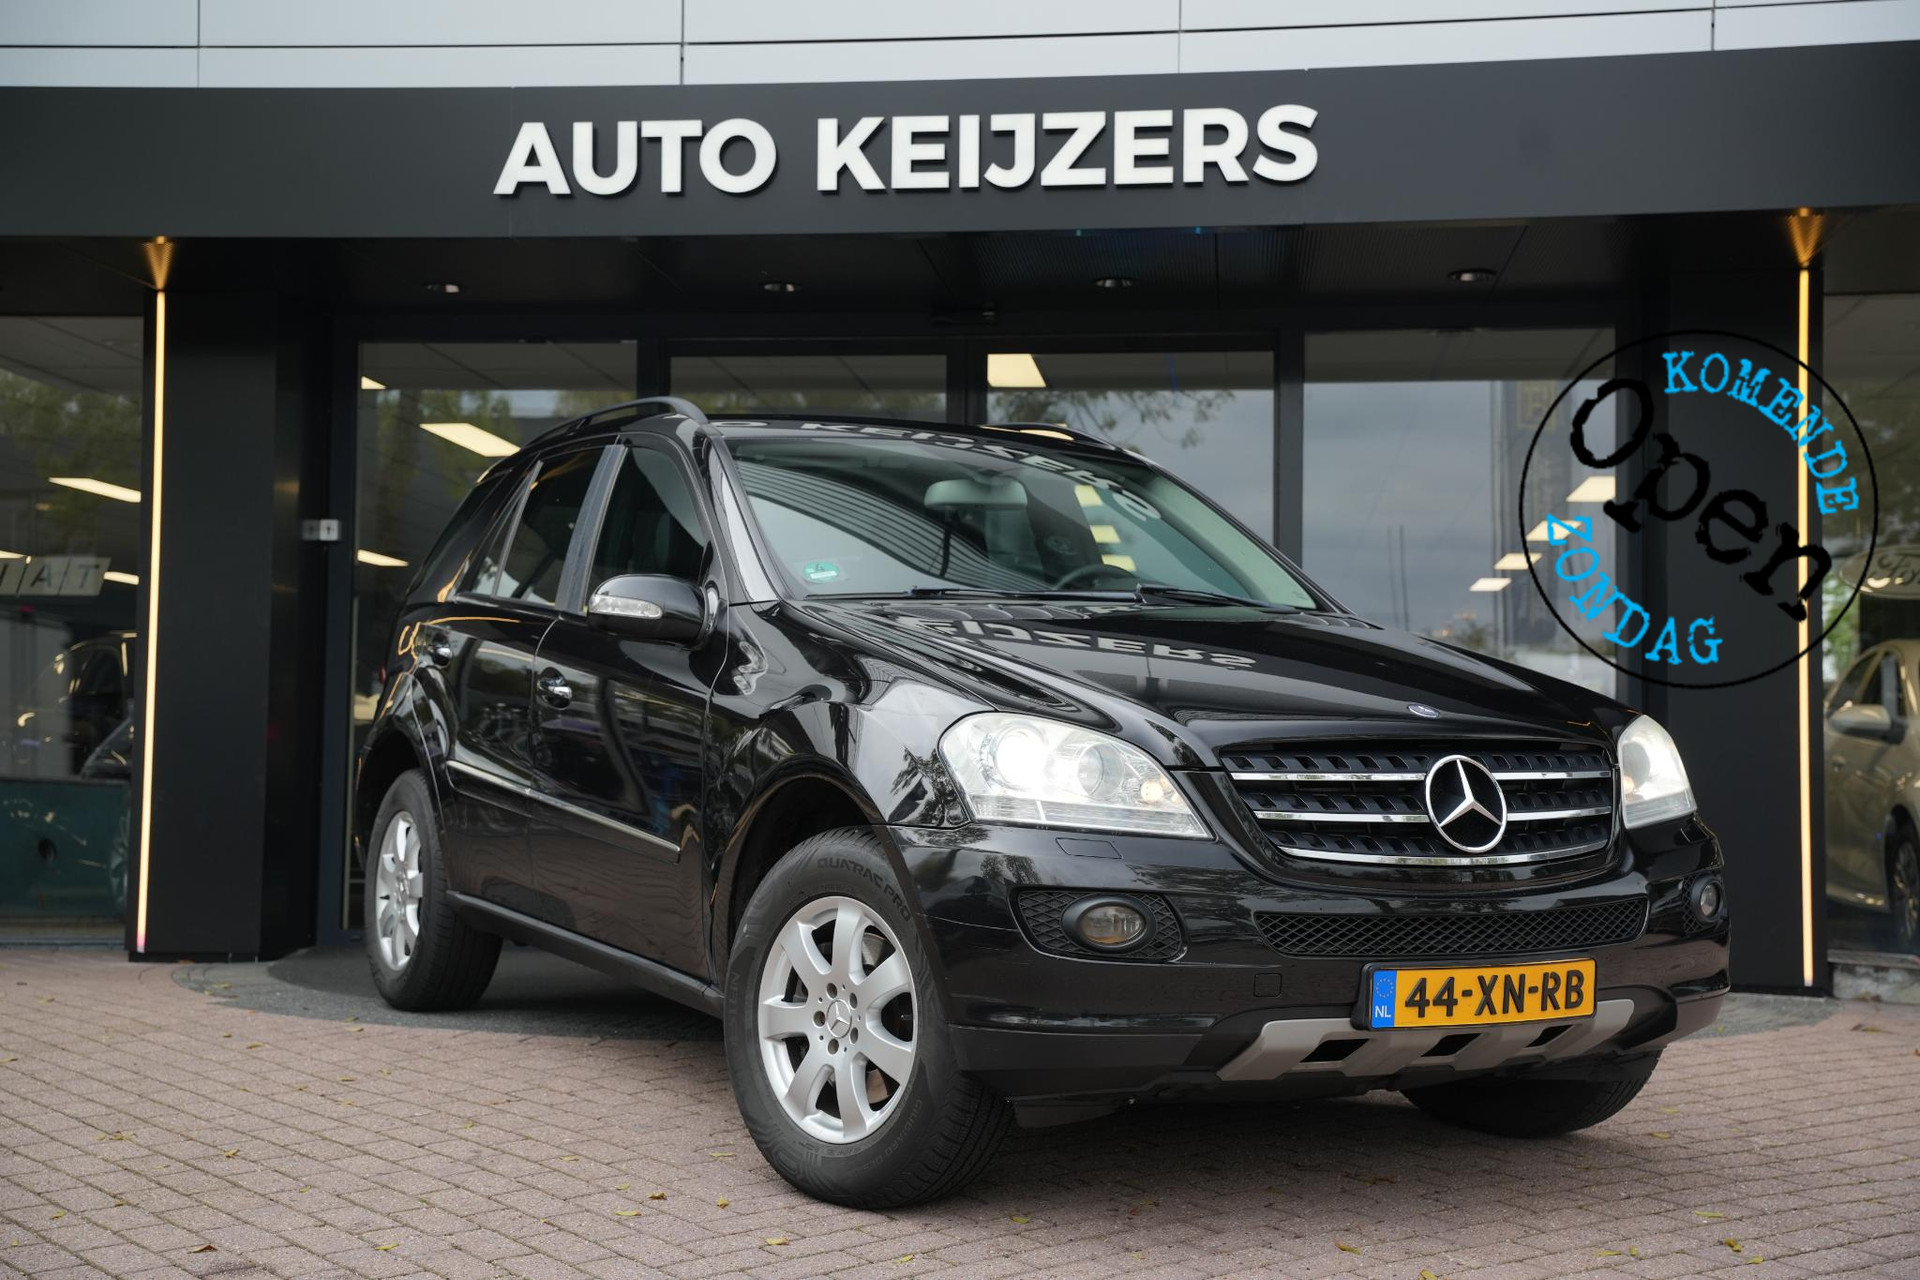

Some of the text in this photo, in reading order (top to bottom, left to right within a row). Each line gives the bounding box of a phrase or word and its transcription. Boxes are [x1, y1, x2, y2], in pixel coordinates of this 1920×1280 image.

[493, 104, 1319, 196] AUTO KEIJZERS
[883, 884, 912, 922] PRO
[1375, 969, 1585, 1019] NL 44-XN-RB
